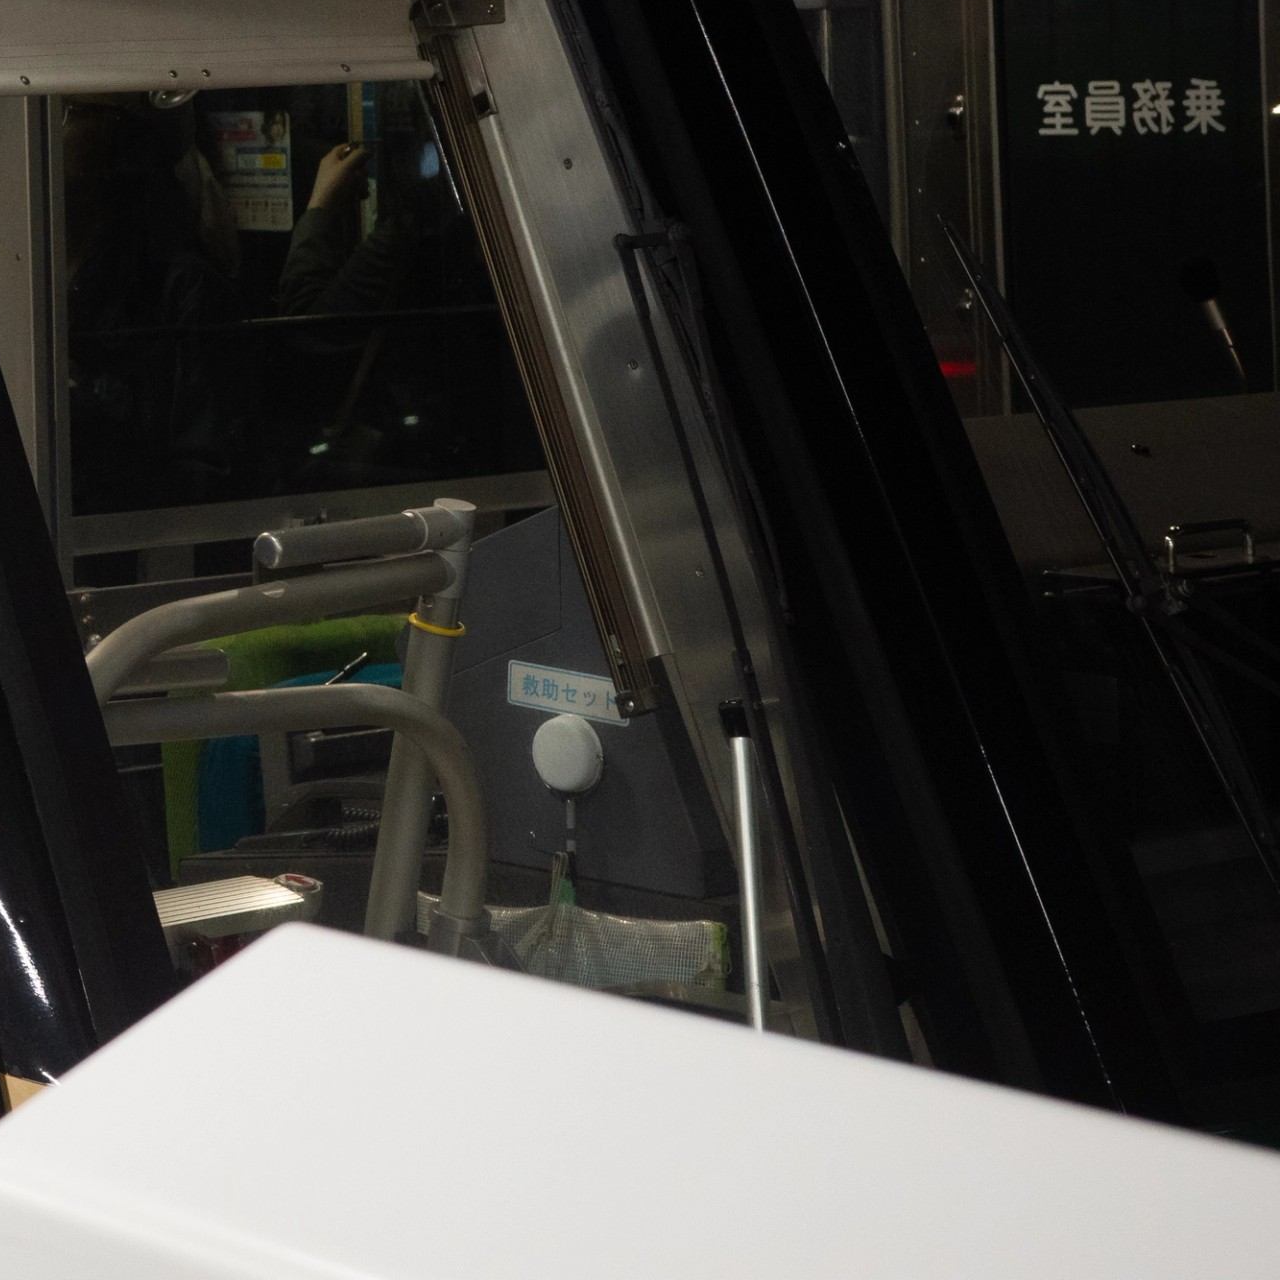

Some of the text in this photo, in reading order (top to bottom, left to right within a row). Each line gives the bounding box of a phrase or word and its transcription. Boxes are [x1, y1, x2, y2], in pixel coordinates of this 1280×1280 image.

[522, 673, 617, 710] 救助セット
